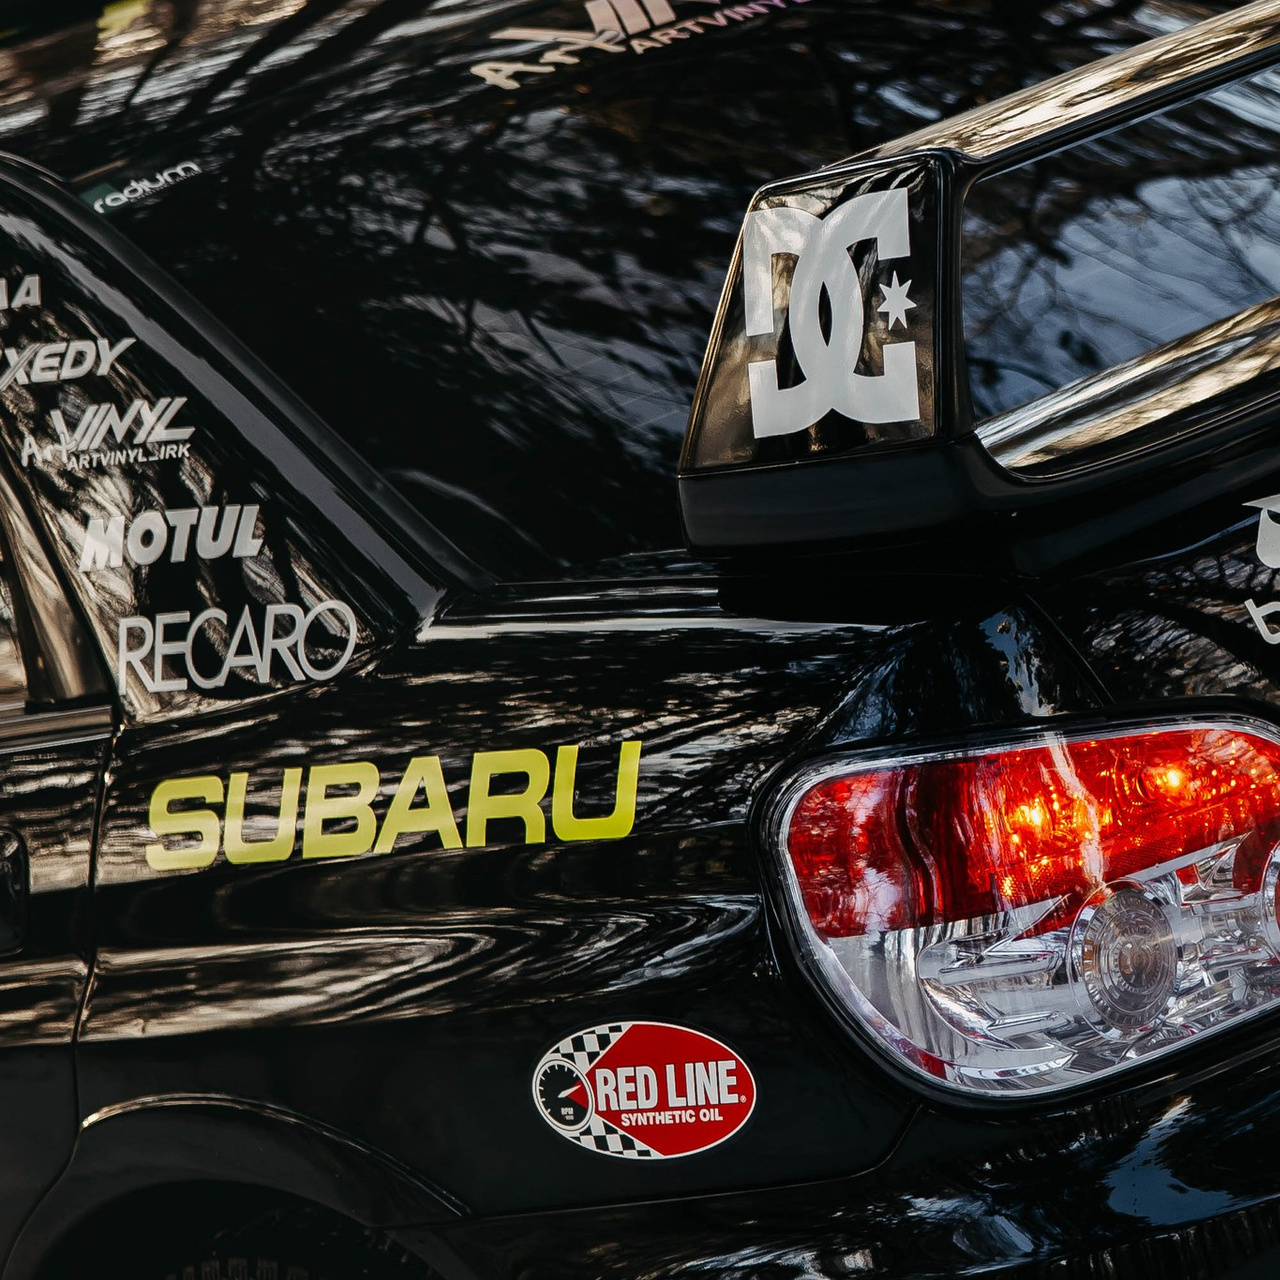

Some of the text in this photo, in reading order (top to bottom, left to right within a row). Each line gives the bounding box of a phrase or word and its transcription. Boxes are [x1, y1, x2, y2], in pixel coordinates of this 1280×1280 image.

[93, 160, 202, 214] radium
[742, 187, 920, 439] DC
[0, 337, 137, 392] XEDY
[66, 442, 192, 472] ARTVINYL_IRK
[79, 504, 265, 573] MOTUL
[118, 599, 358, 697] RECARO
[145, 739, 643, 873] SUBARU
[595, 1059, 740, 1112] RED LINE
[621, 1107, 724, 1128] SYNTHETIC OIL
